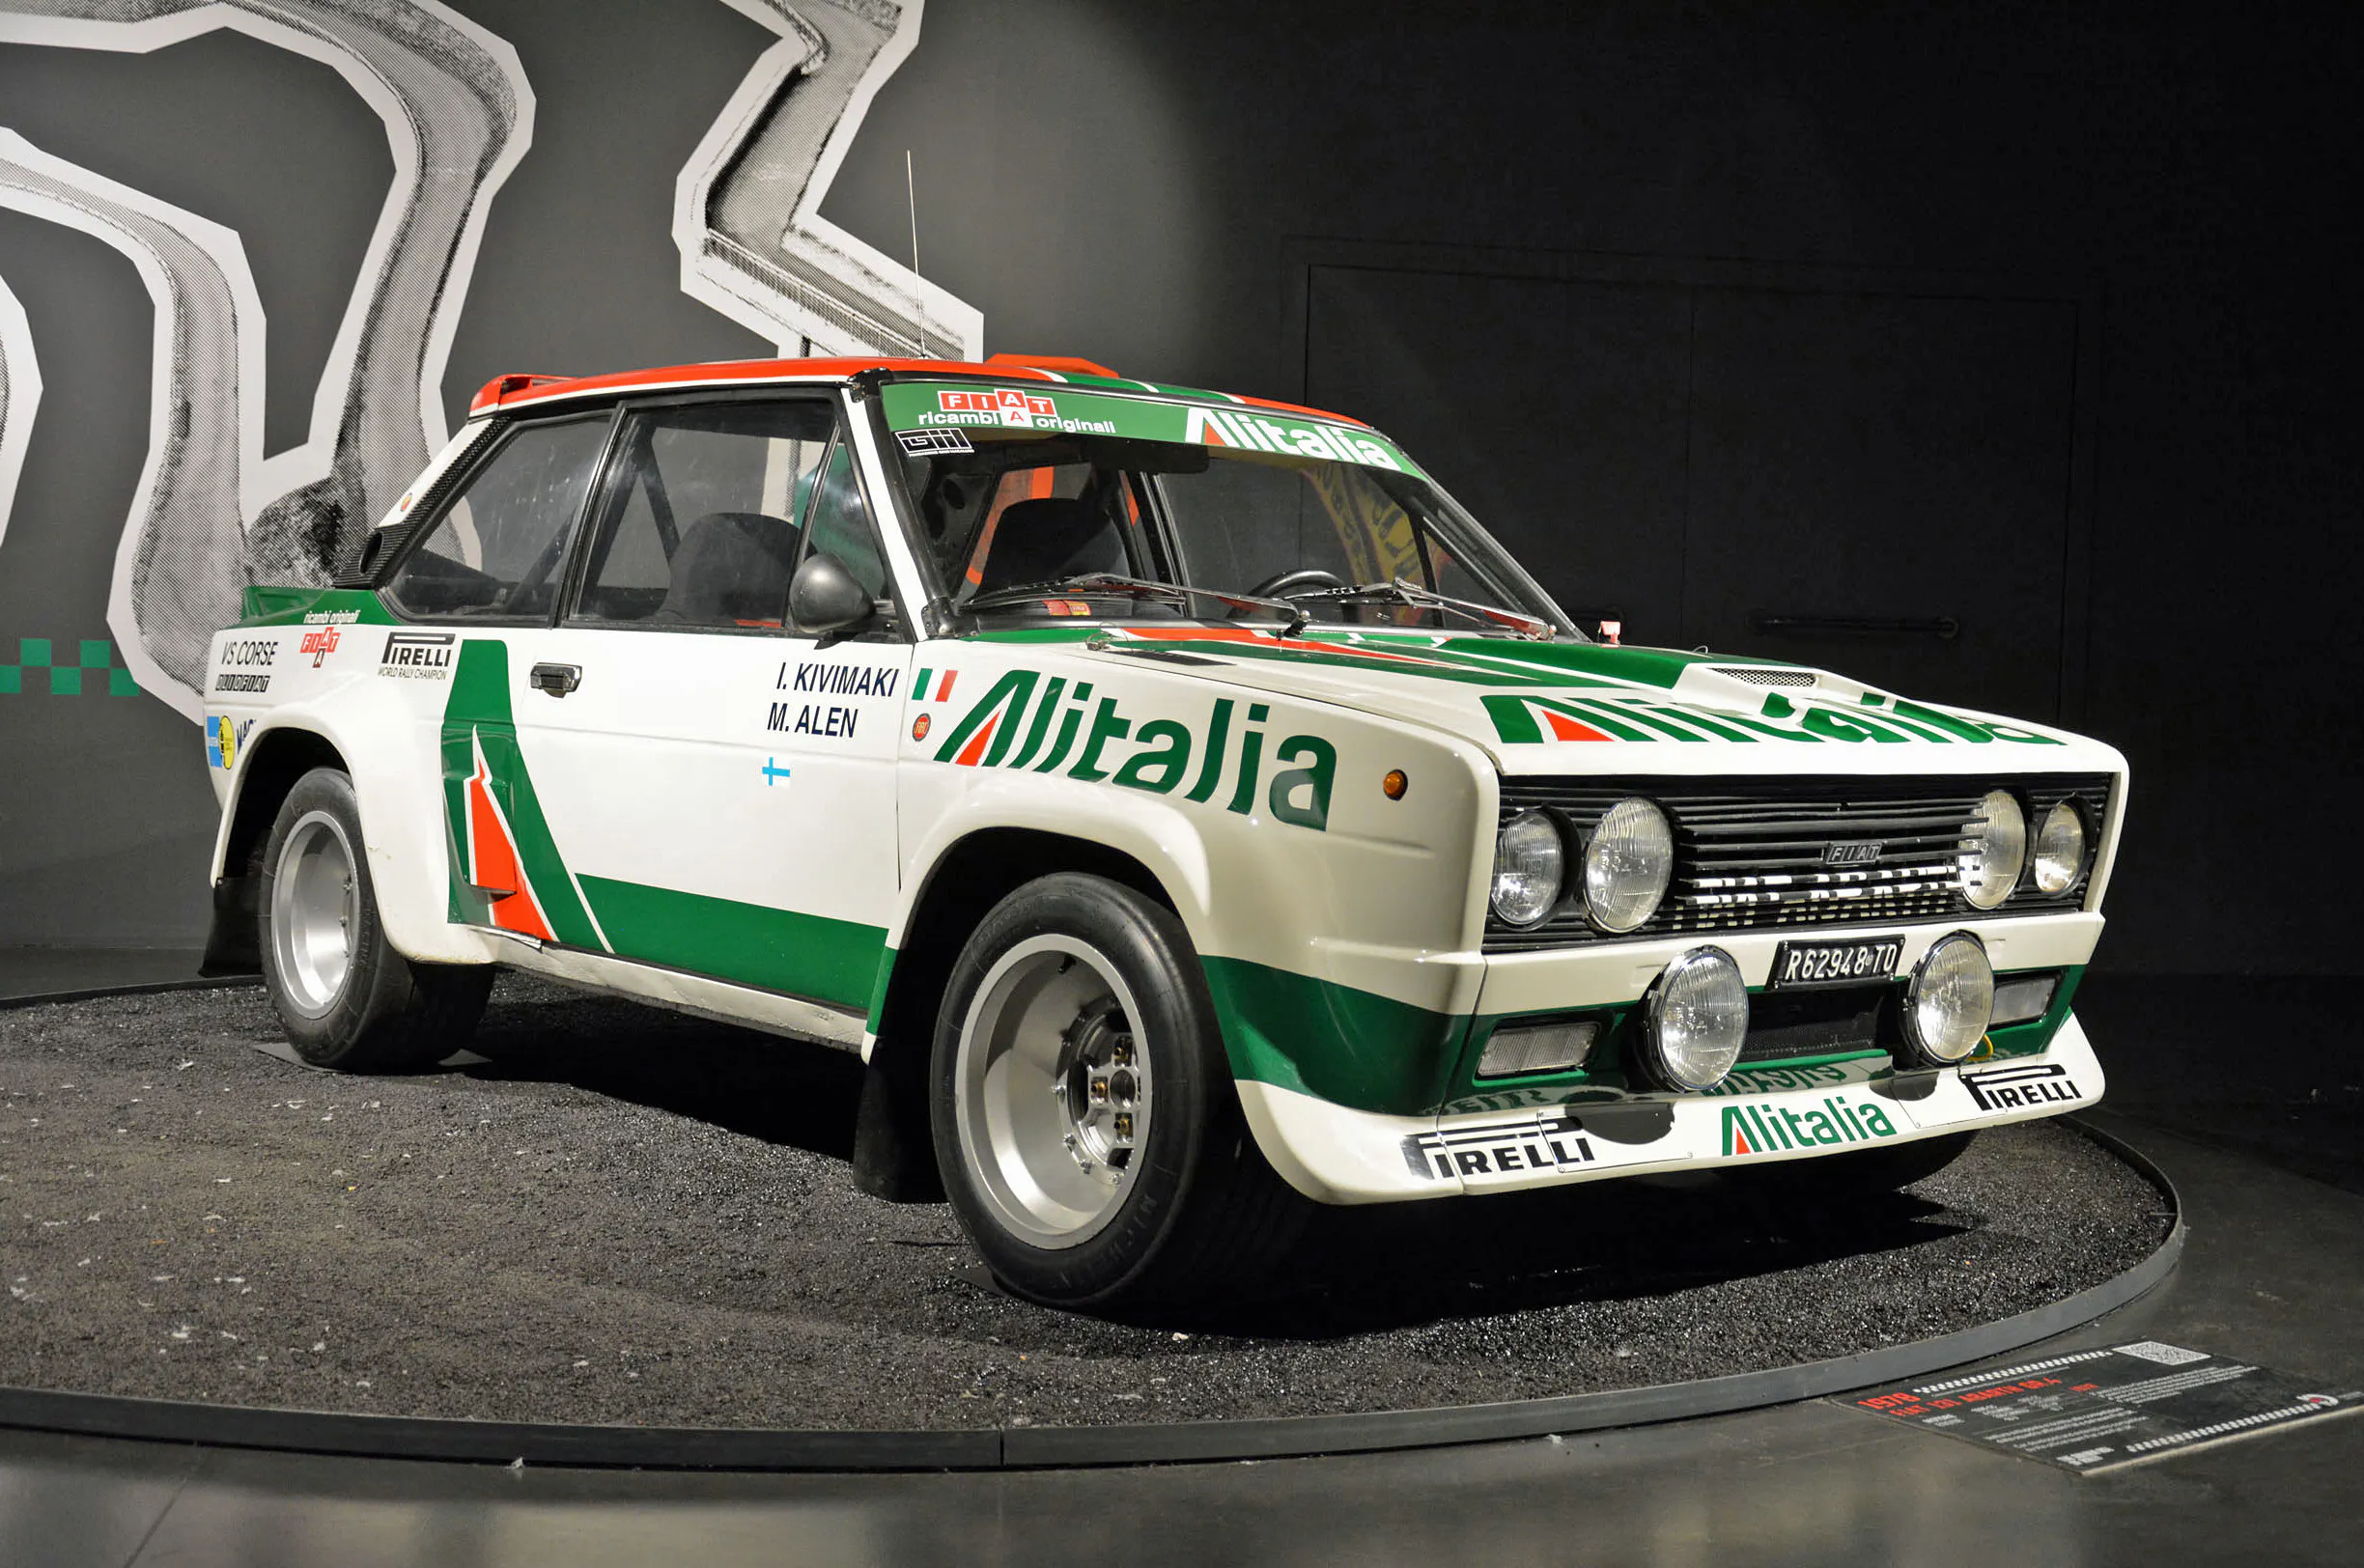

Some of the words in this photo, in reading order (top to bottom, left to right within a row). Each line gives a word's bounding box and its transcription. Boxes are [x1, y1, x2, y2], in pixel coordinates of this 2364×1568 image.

[946, 391, 1050, 414] FIAT
[918, 411, 999, 425] ricambi
[1036, 416, 1116, 434] originali
[1185, 406, 1402, 471] Alitalia
[303, 610, 331, 624] ricambi
[221, 641, 237, 665] VS
[237, 641, 278, 665] CORSE
[300, 626, 341, 653] FIAT
[381, 631, 456, 667] PIRELLI
[378, 667, 398, 678] WORLD
[399, 667, 413, 679] RALLY
[414, 668, 447, 681] CHAMPION
[775, 662, 788, 689] I.
[794, 664, 899, 697] KIVIMAKI
[767, 703, 790, 732] M.
[795, 706, 858, 739] ALEN
[933, 669, 1337, 833] Alitalia
[1828, 843, 1881, 862] FIAT
[1785, 946, 1869, 981] R62948
[1872, 943, 1898, 973] TO
[1959, 1063, 2083, 1112] PIRELLI
[1721, 1097, 1898, 1158] Alitalia
[1400, 1116, 1595, 1180] PIRELLI
[1857, 1391, 1922, 1411] 1978
